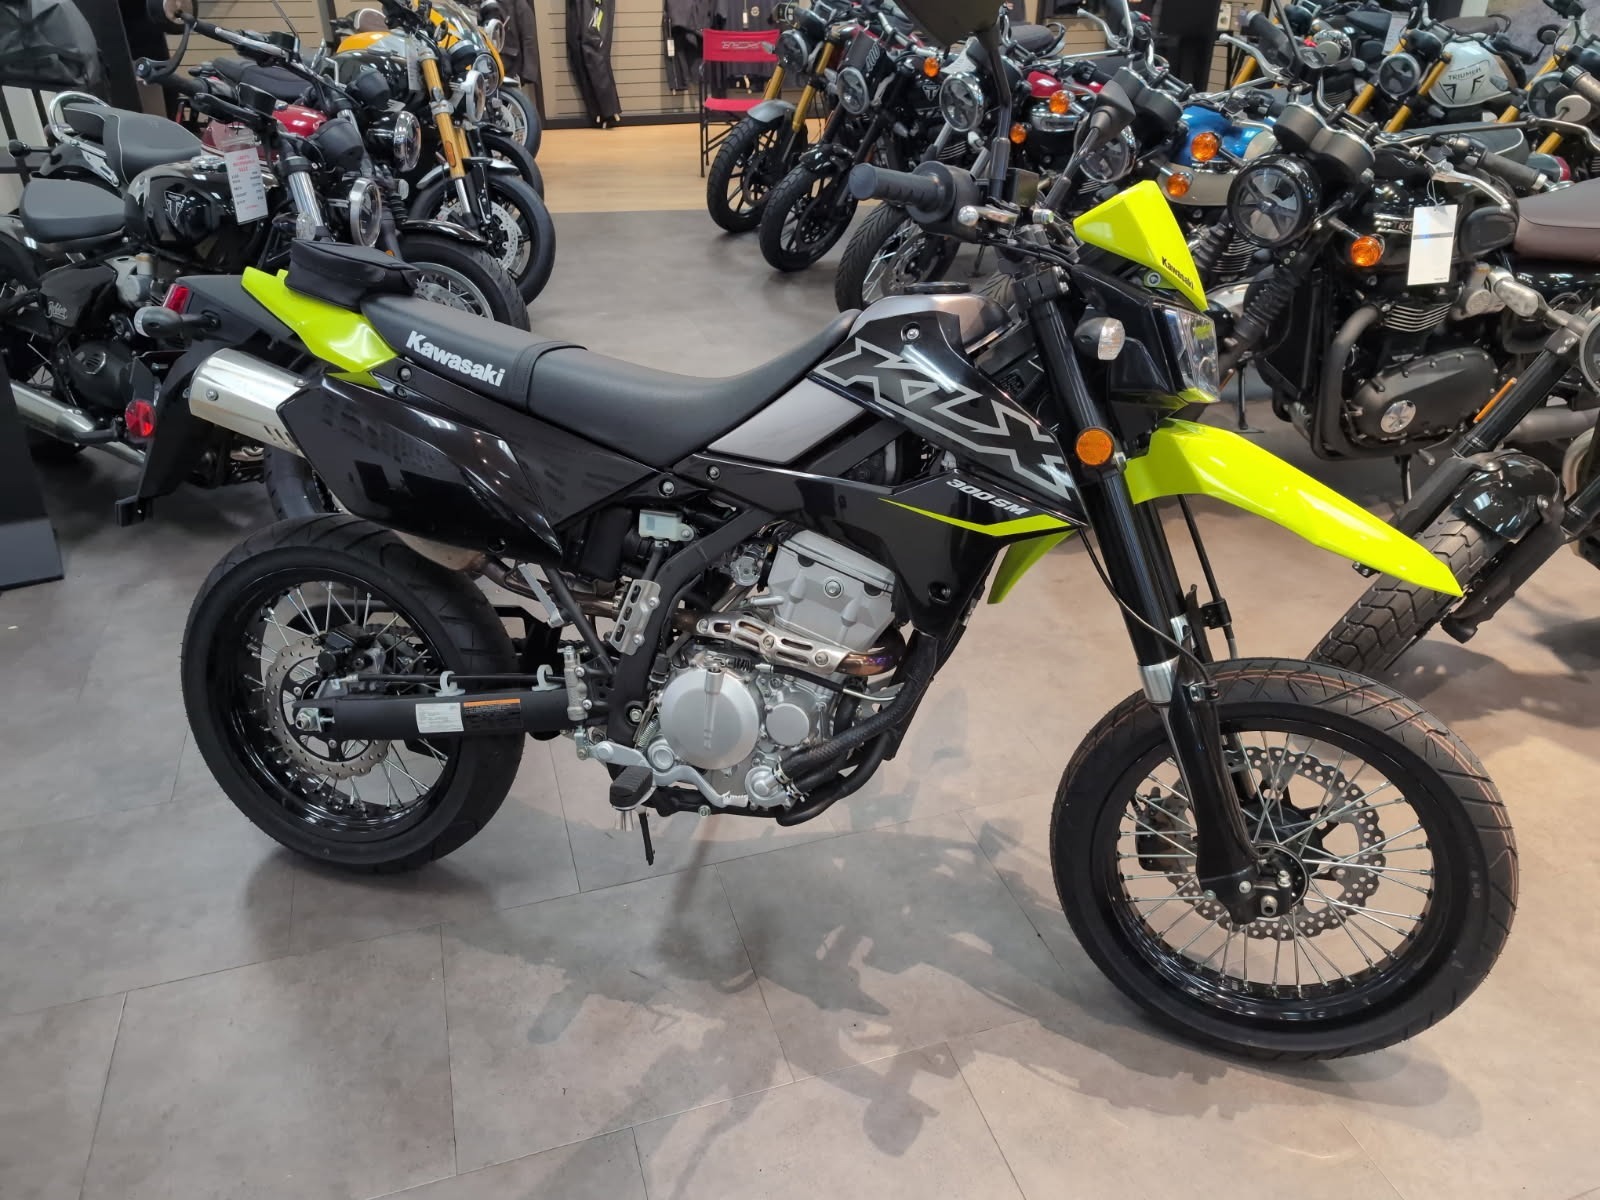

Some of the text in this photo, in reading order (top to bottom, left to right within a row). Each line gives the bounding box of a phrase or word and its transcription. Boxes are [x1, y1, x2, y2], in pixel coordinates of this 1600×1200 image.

[1162, 256, 1194, 290] Kawasaki
[406, 330, 506, 387] Kawasaki
[946, 478, 1030, 516] 300SM
